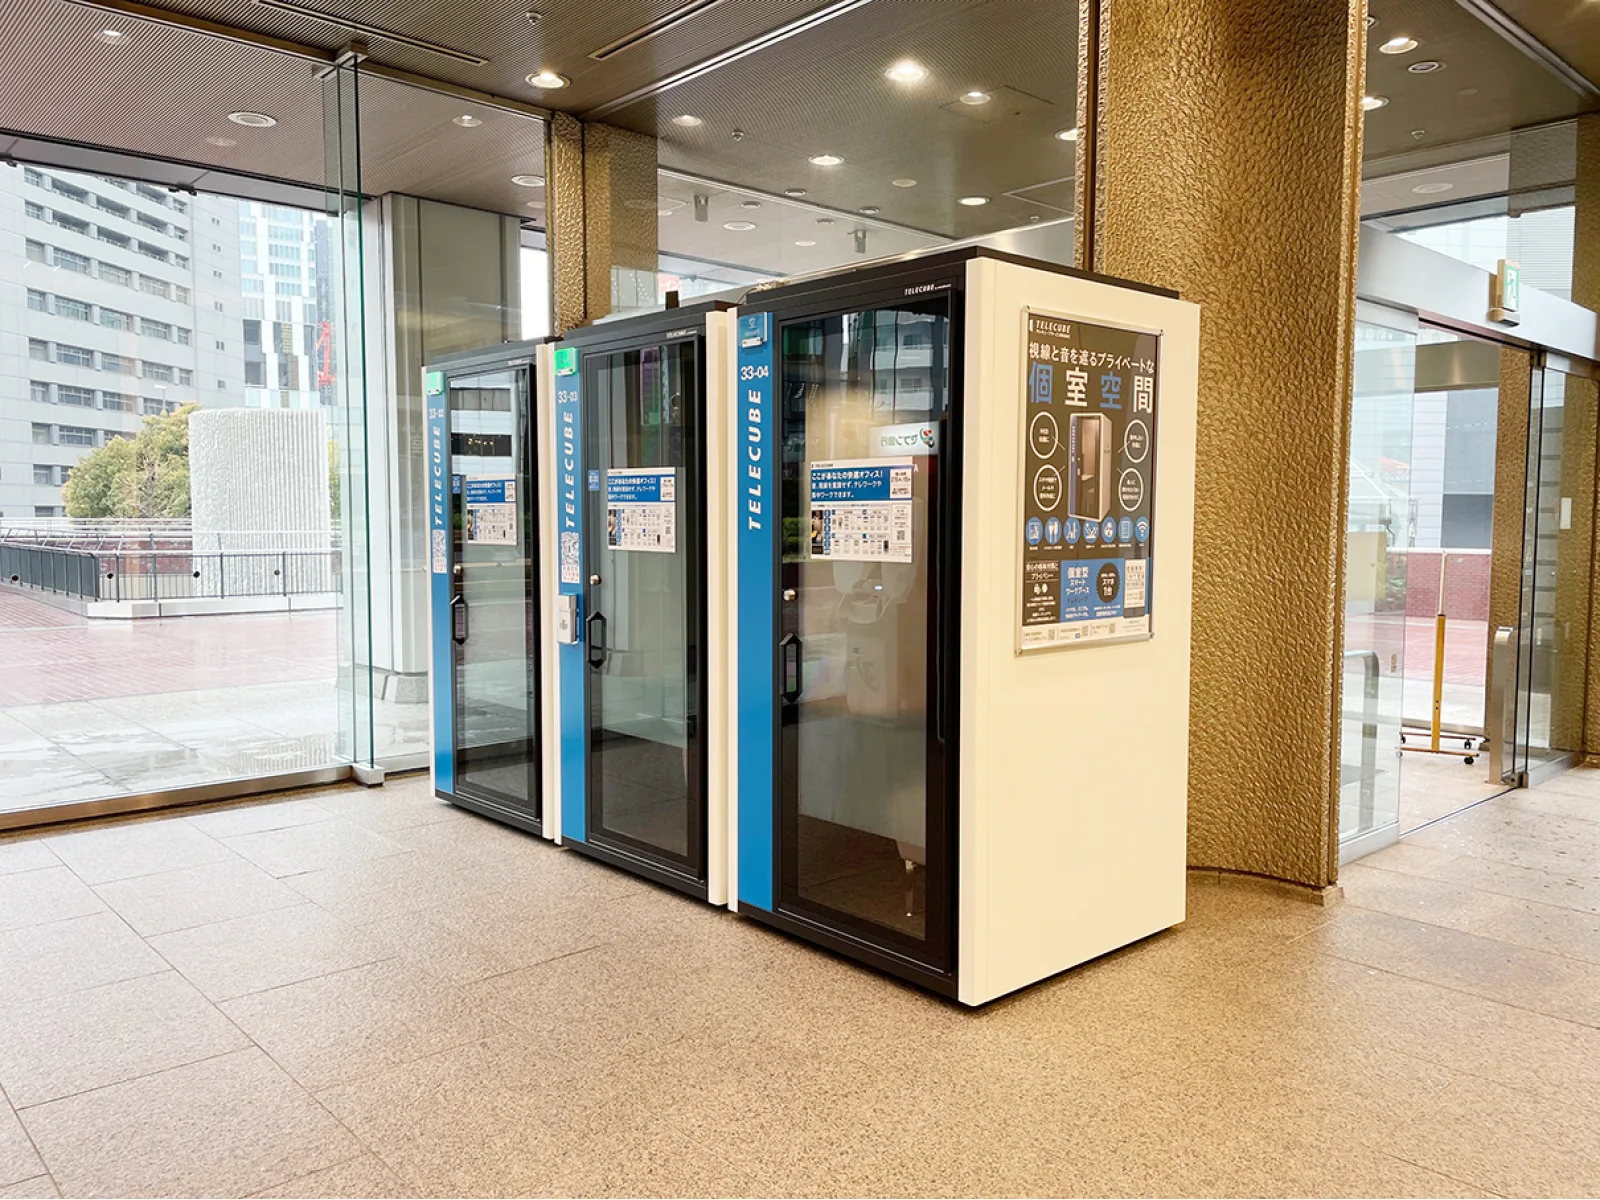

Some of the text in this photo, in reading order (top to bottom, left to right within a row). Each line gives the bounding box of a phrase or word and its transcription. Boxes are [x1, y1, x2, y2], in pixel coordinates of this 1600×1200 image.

[1036, 319, 1071, 334] TELECUBE
[741, 365, 769, 380] 33-04
[1029, 341, 1155, 374] 視線と音を遮るプライベートな
[1029, 361, 1154, 413] 個室空間
[433, 425, 443, 526] TELECUBE
[563, 411, 576, 528] TELECUBE
[748, 389, 762, 530] TELECUBE
